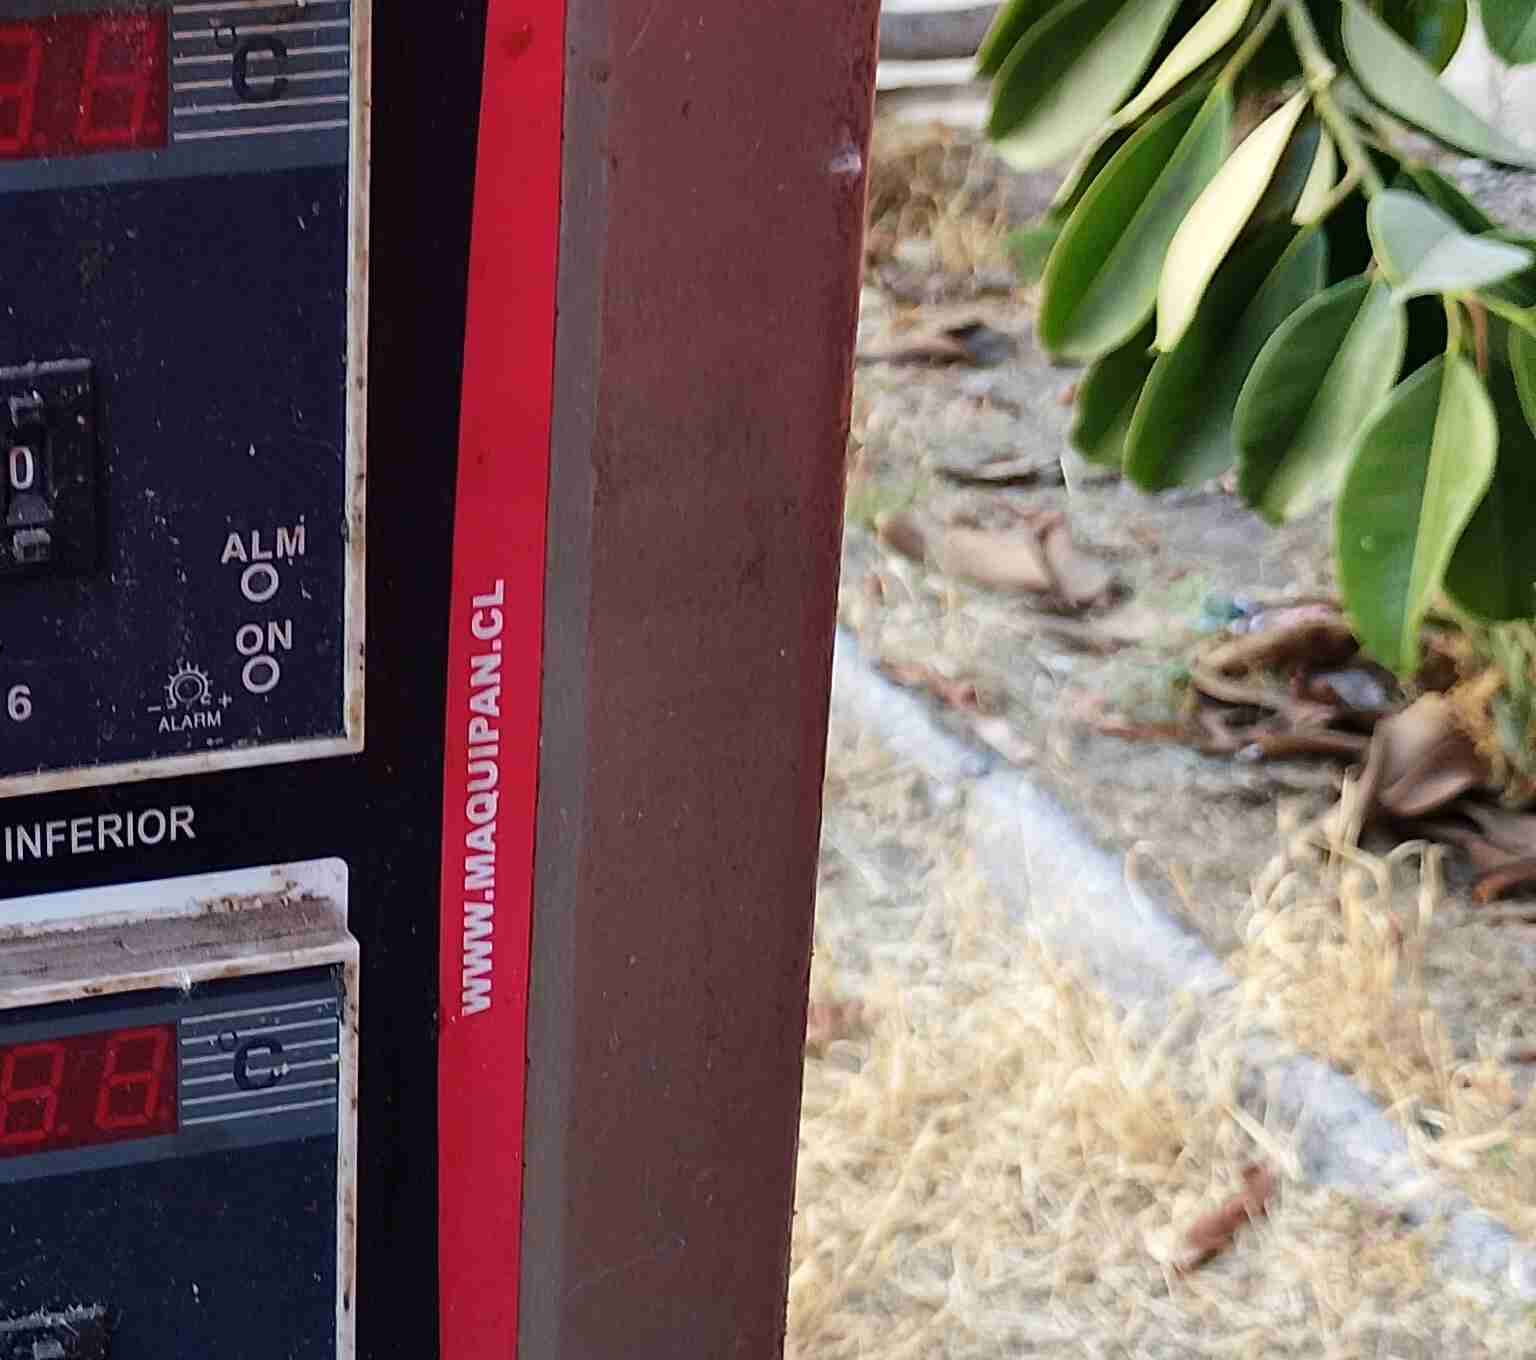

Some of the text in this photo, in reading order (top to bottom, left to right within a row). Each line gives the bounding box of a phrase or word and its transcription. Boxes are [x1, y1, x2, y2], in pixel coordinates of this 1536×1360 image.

[220, 524, 308, 563] ALM
[233, 618, 294, 655] ON
[157, 707, 224, 734] ALARM
[460, 577, 505, 1017] WWW.MAQUIPAN.CL
[2, 803, 197, 863] INFERIOR
